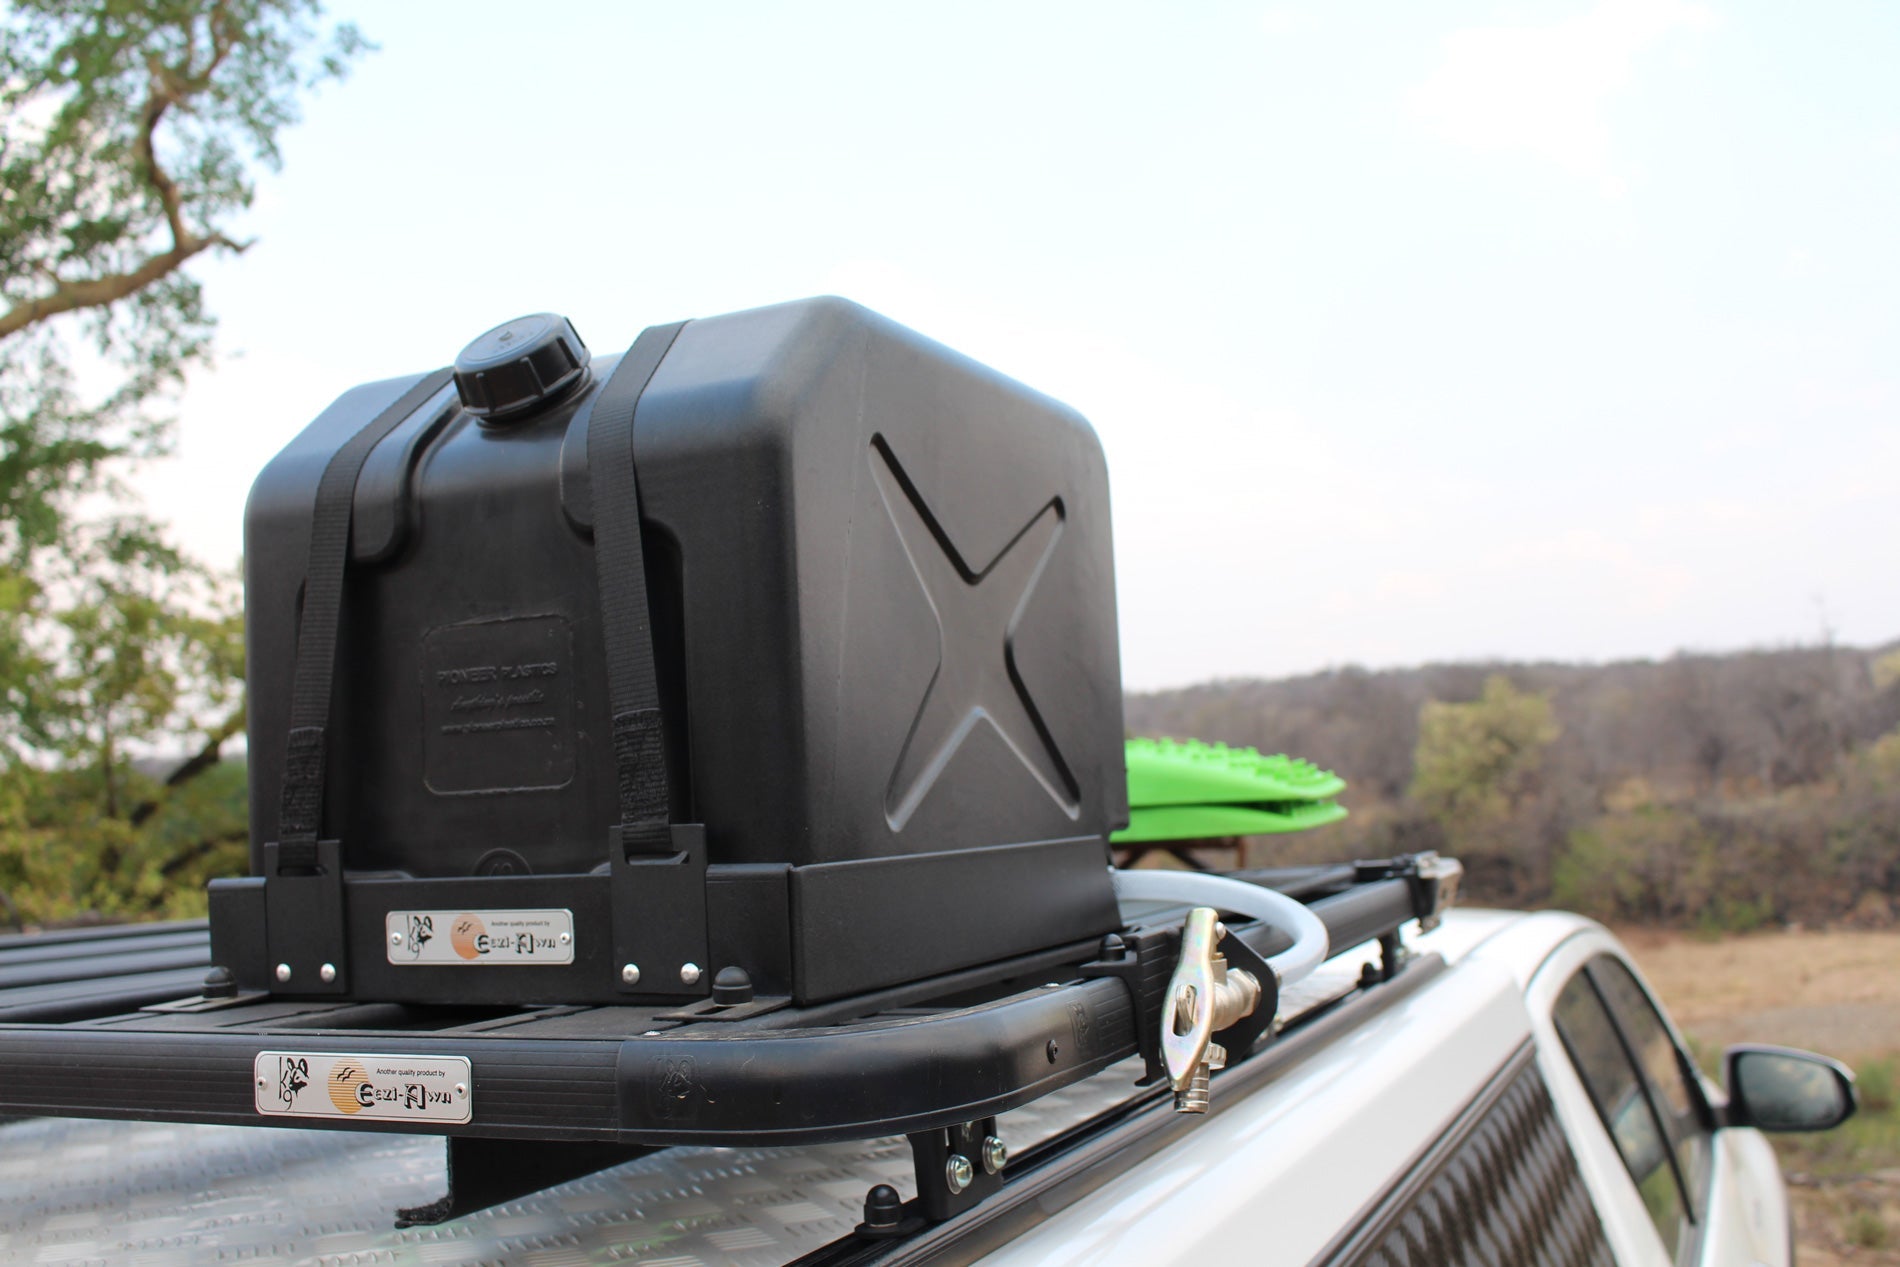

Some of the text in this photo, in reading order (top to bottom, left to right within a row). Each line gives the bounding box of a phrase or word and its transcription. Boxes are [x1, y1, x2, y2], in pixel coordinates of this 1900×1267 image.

[510, 920, 524, 928] quality
[525, 920, 543, 928] product
[376, 1067, 446, 1078] Another quality product by
[355, 1082, 452, 1110] Eezi-Awn
